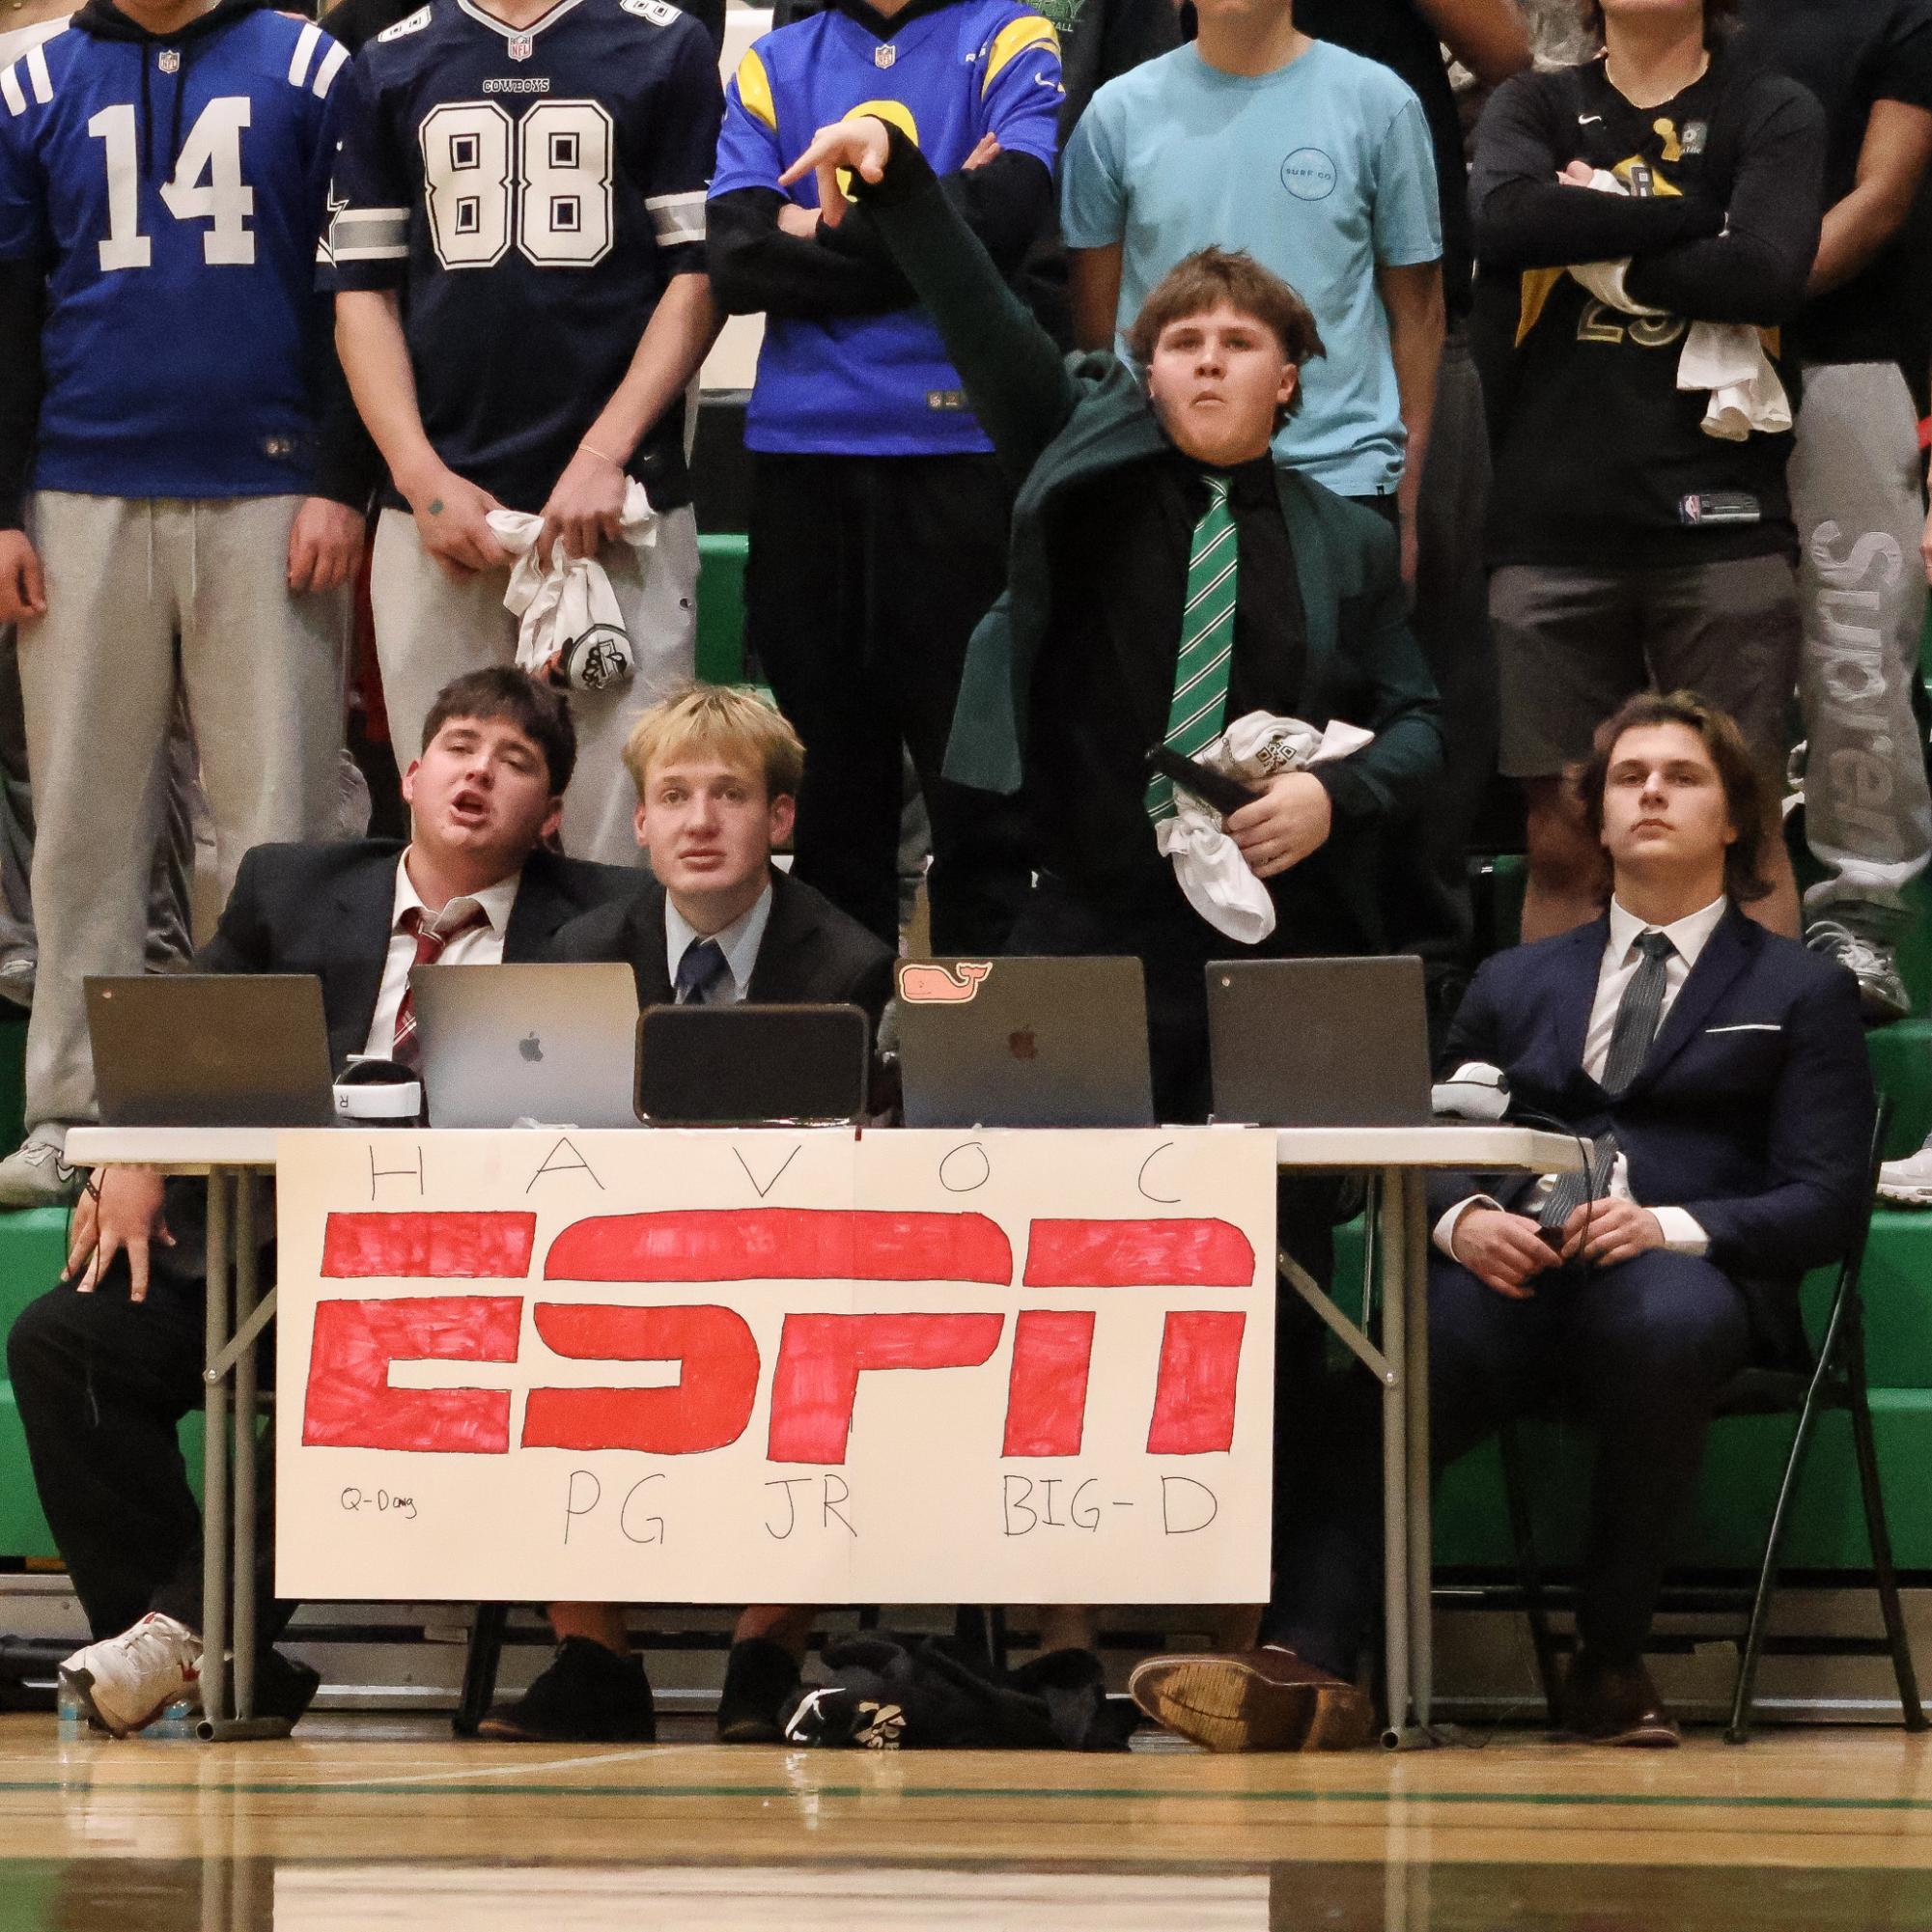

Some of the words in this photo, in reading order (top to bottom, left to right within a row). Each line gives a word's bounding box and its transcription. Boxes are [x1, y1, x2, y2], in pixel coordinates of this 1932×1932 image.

[483, 78, 549, 93] COWBOYS
[88, 97, 255, 271] 14
[419, 99, 614, 270] 88
[302, 1208, 1254, 1465] ESPN
